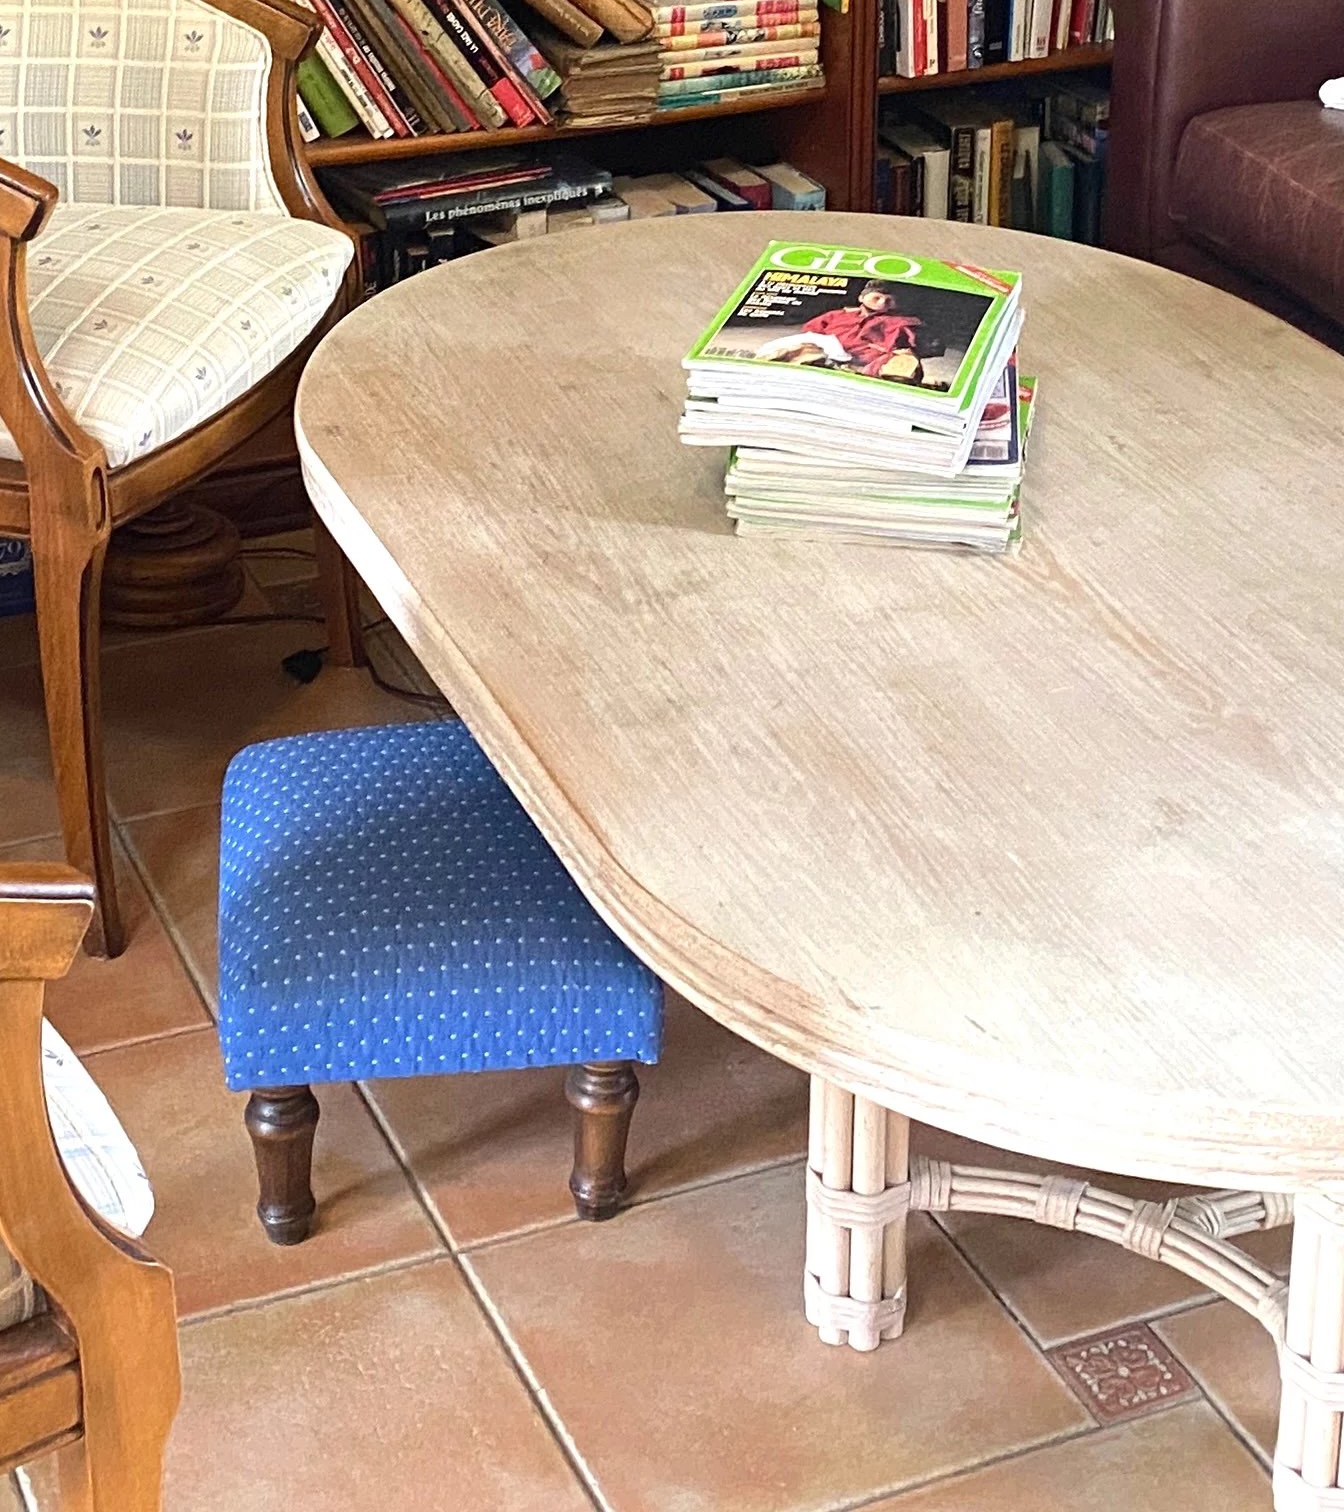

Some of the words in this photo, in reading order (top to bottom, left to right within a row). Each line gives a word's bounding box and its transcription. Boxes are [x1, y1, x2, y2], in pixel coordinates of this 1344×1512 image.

[426, 210, 445, 222] Les
[448, 197, 521, 220] phénomènes
[523, 187, 588, 206] inexpliqués
[769, 246, 922, 278] GEO
[764, 272, 848, 288] HIMALAYA
